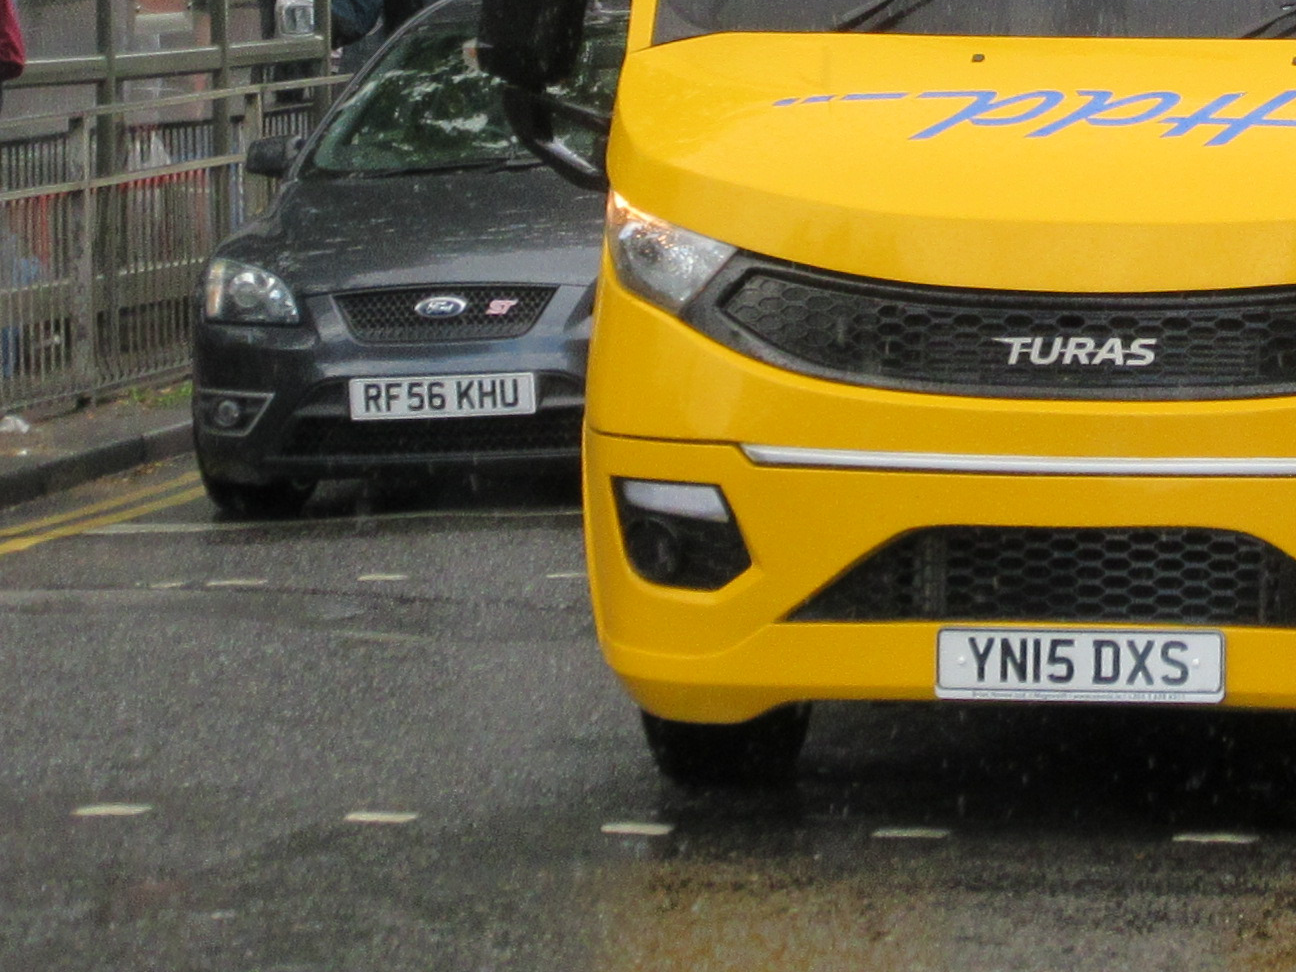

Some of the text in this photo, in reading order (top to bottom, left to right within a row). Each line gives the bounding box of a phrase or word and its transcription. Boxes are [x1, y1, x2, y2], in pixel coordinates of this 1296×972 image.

[992, 336, 1157, 368] TURAS
[364, 379, 521, 414] RF56 KHU
[967, 636, 1190, 687] YN15 DXS
